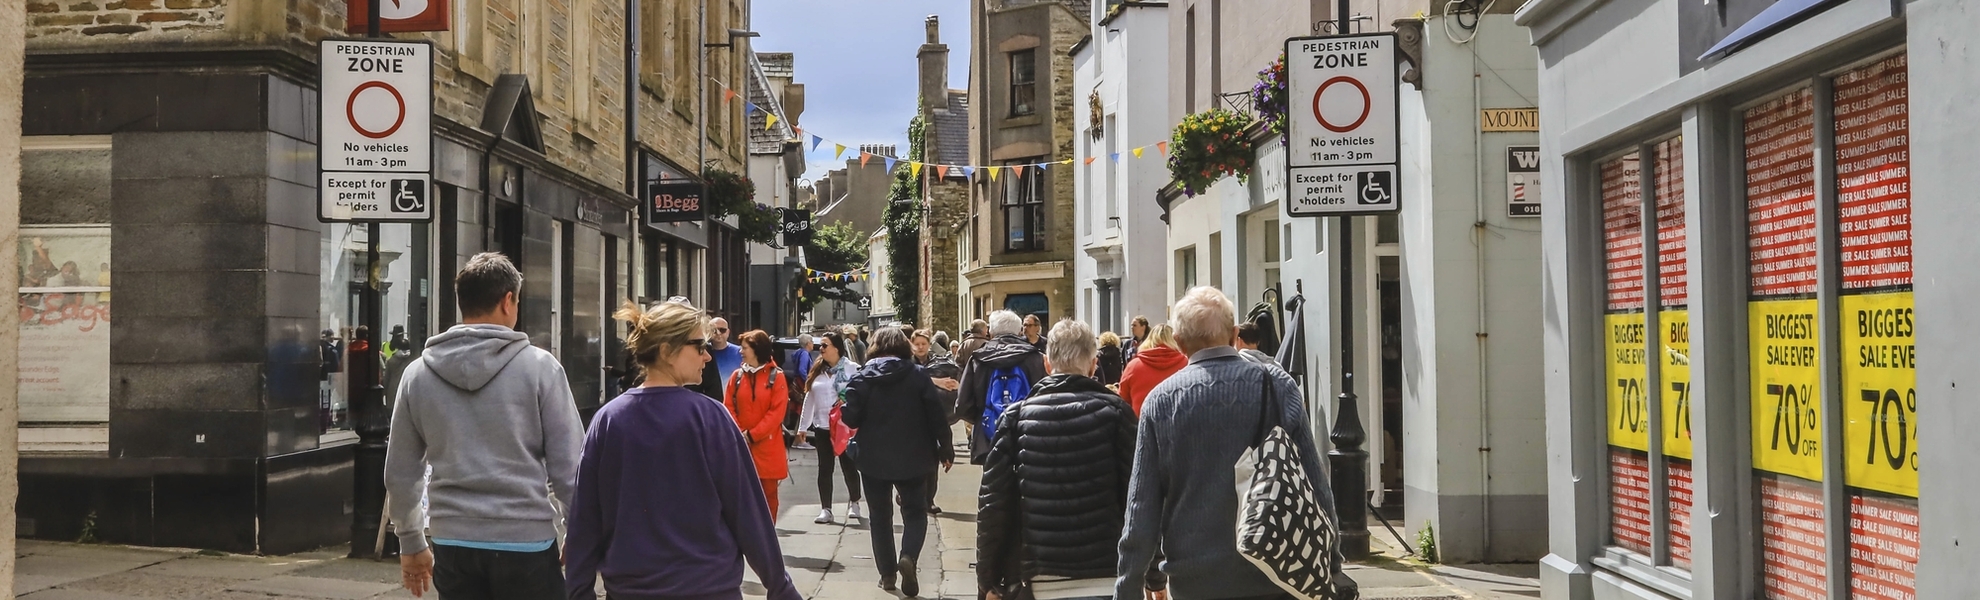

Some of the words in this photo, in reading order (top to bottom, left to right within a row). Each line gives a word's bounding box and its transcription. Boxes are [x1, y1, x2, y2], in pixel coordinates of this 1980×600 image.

[337, 45, 415, 56] PEDESTRIAN
[1303, 40, 1379, 52] PEDESTRIAN
[348, 58, 403, 73] ZONE
[1314, 53, 1368, 69] ZONE
[1850, 69, 1865, 83] SALE
[1867, 62, 1885, 77] SUMMER
[1886, 56, 1905, 68] SALE
[1838, 84, 1866, 100] SUMMER
[1867, 80, 1879, 92] SALE
[1879, 72, 1906, 88] SUMMER
[1852, 100, 1866, 112] SALE
[1867, 92, 1886, 107] SUMMER
[1887, 88, 1906, 100] SALE
[1840, 115, 1866, 130] SUMMER
[1867, 112, 1879, 124] SALE
[1879, 104, 1906, 120] SUMMER
[1852, 129, 1866, 142] SALE
[1867, 125, 1887, 138] SUMMER
[1888, 119, 1906, 133] SALE
[344, 143, 359, 152] No
[364, 143, 409, 152] vehicles
[1311, 138, 1326, 147] No
[1330, 137, 1374, 146] vehicles
[1841, 145, 1866, 160] SUMMER
[1867, 142, 1878, 154] SALE
[1878, 134, 1906, 151] SUMMER
[1853, 159, 1866, 172] SALE
[1866, 154, 1888, 170] SUMMER
[1888, 151, 1906, 163] SALE
[328, 179, 366, 188] Except
[371, 179, 386, 188] for
[1296, 174, 1333, 183] Except
[1338, 174, 1353, 182] for
[1841, 175, 1865, 189] SUMMER
[1866, 172, 1878, 184] SALE
[1879, 167, 1907, 181] SUMMER
[339, 191, 375, 200] permit
[1307, 185, 1342, 195] permit
[1752, 196, 1771, 208] SUMMER
[1772, 193, 1781, 205] SALE
[1781, 189, 1800, 202] SUMMER
[1802, 186, 1813, 198] SALE
[1853, 190, 1866, 201] SALE
[1866, 187, 1889, 198] SUMMER
[1890, 182, 1907, 194] SALE
[337, 201, 378, 212] lders
[663, 194, 699, 211] Begg
[1304, 197, 1345, 205] holders
[1761, 208, 1772, 220] SALE
[1772, 204, 1790, 218] SUMMER
[1791, 201, 1801, 213] SALE
[1841, 205, 1866, 218] SUMMER
[1868, 202, 1880, 214] SALE
[1880, 198, 1907, 212] SUMMER
[1753, 222, 1773, 234] SUMMER
[1774, 219, 1782, 230] SALE
[1783, 216, 1802, 229] SUMMER
[1803, 213, 1814, 224] SALE
[1854, 219, 1868, 231] SALE
[1868, 217, 1890, 228] SUMMER
[1891, 214, 1907, 225] SALE
[1762, 234, 1774, 246] SALE
[1774, 232, 1791, 243] SUMMER
[1792, 229, 1803, 240] SALE
[1842, 235, 1869, 248] SUMMER
[1870, 232, 1881, 244] SALE
[1881, 230, 1908, 243] SUMMER
[1754, 248, 1774, 260] SUMMER
[1775, 245, 1784, 257] SALE
[1784, 243, 1804, 256] SUMMER
[1805, 241, 1816, 252] SALE
[1853, 248, 1869, 261] SALE
[1870, 248, 1892, 259] SUMMER
[1893, 245, 1908, 256] SALE
[1764, 260, 1775, 272] SALE
[1776, 258, 1793, 271] SUMMER
[1794, 256, 1805, 268] SALE
[1843, 265, 1869, 276] SUMMER
[1871, 263, 1882, 275] SALE
[1882, 262, 1909, 273] SUMMER
[1756, 274, 1776, 287] SUMMER
[1776, 272, 1785, 284] SALE
[1786, 270, 1806, 282] SUMMER
[1806, 269, 1817, 280] SALE
[1766, 314, 1813, 339] BIGGEST
[1616, 349, 1630, 364] SALE
[1767, 345, 1788, 365] SALE
[1791, 346, 1814, 367] EVER
[1859, 345, 1887, 368] SALE
[1767, 383, 1816, 455] 70%
[1802, 439, 1817, 457] OFF
[1851, 505, 1878, 518] SUMMER
[1879, 509, 1892, 521] SALE
[1893, 511, 1918, 525] SUMMER
[1862, 520, 1877, 532] SALE
[1878, 523, 1902, 536] SUMMER
[1903, 529, 1917, 540] SALE
[1850, 534, 1876, 548] SUMMER
[1878, 538, 1892, 550] SALE
[1894, 542, 1916, 558] SUMMER
[1862, 550, 1876, 562] SALE
[1877, 554, 1902, 570] SUMMER
[1851, 563, 1877, 578] SUMMER
[1878, 569, 1893, 582] SALE
[1862, 580, 1877, 594] SALE
[1878, 584, 1903, 599] SUMMER
